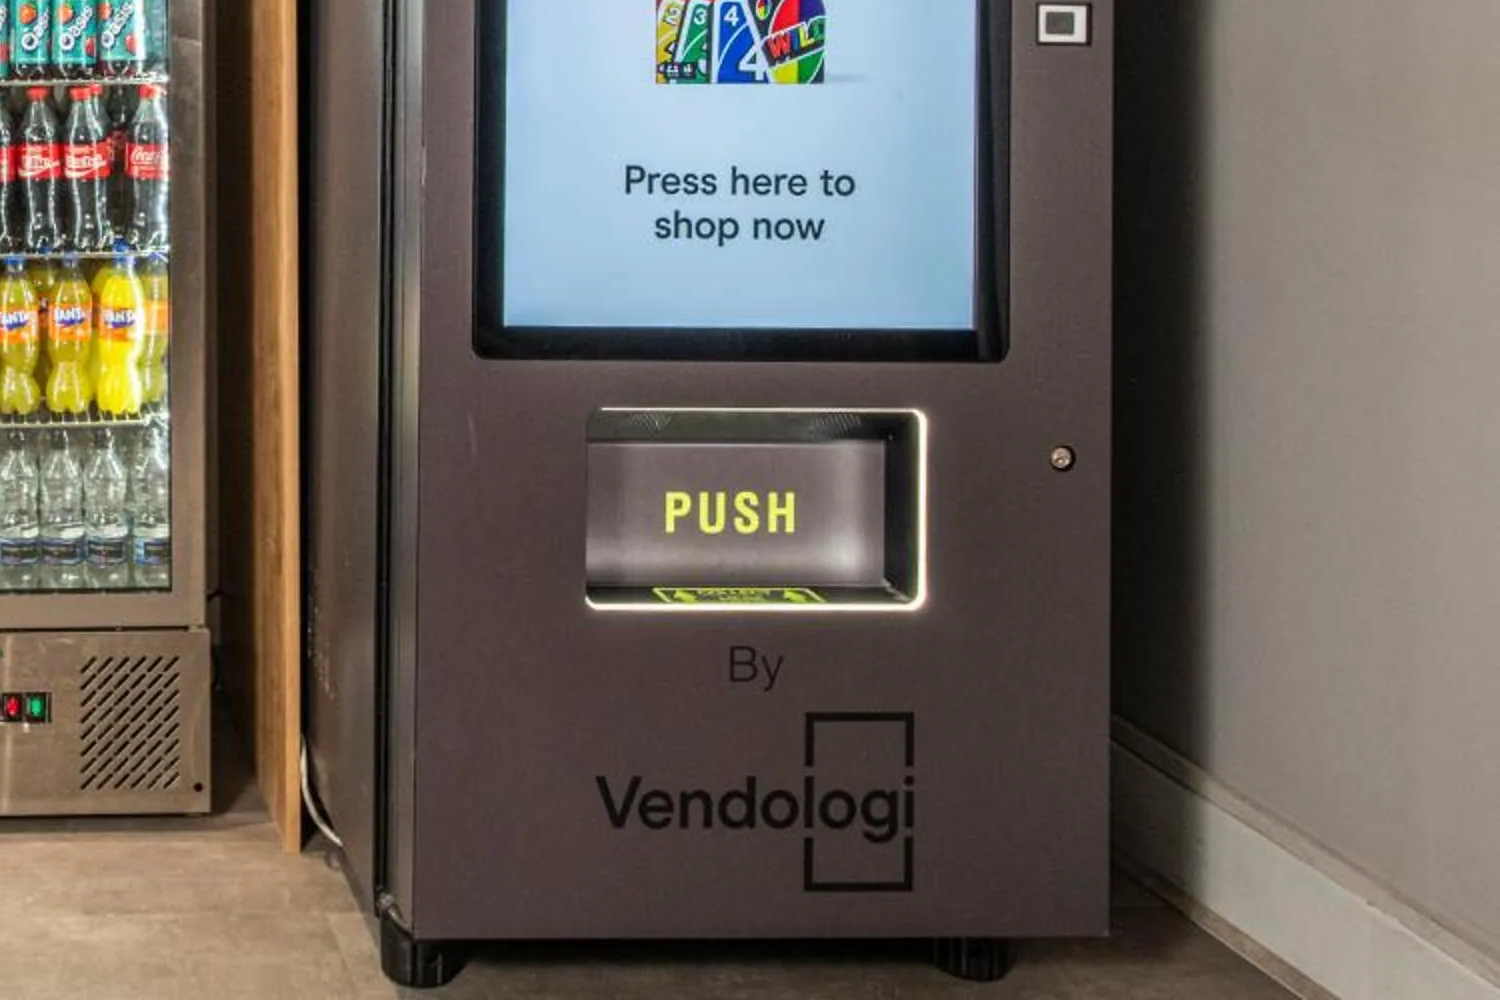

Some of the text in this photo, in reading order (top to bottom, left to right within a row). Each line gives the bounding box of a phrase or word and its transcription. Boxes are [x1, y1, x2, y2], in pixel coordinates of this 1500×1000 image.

[55, 5, 93, 52] Oasis
[100, 1, 133, 50] Oasis
[662, 7, 682, 26] 2
[693, 7, 707, 25] 3
[723, 5, 740, 27] 4
[624, 165, 856, 197] Press here to
[654, 210, 825, 247] shop now
[663, 491, 796, 535] PUSH
[728, 646, 784, 691] By
[595, 775, 916, 844] Vendologi
